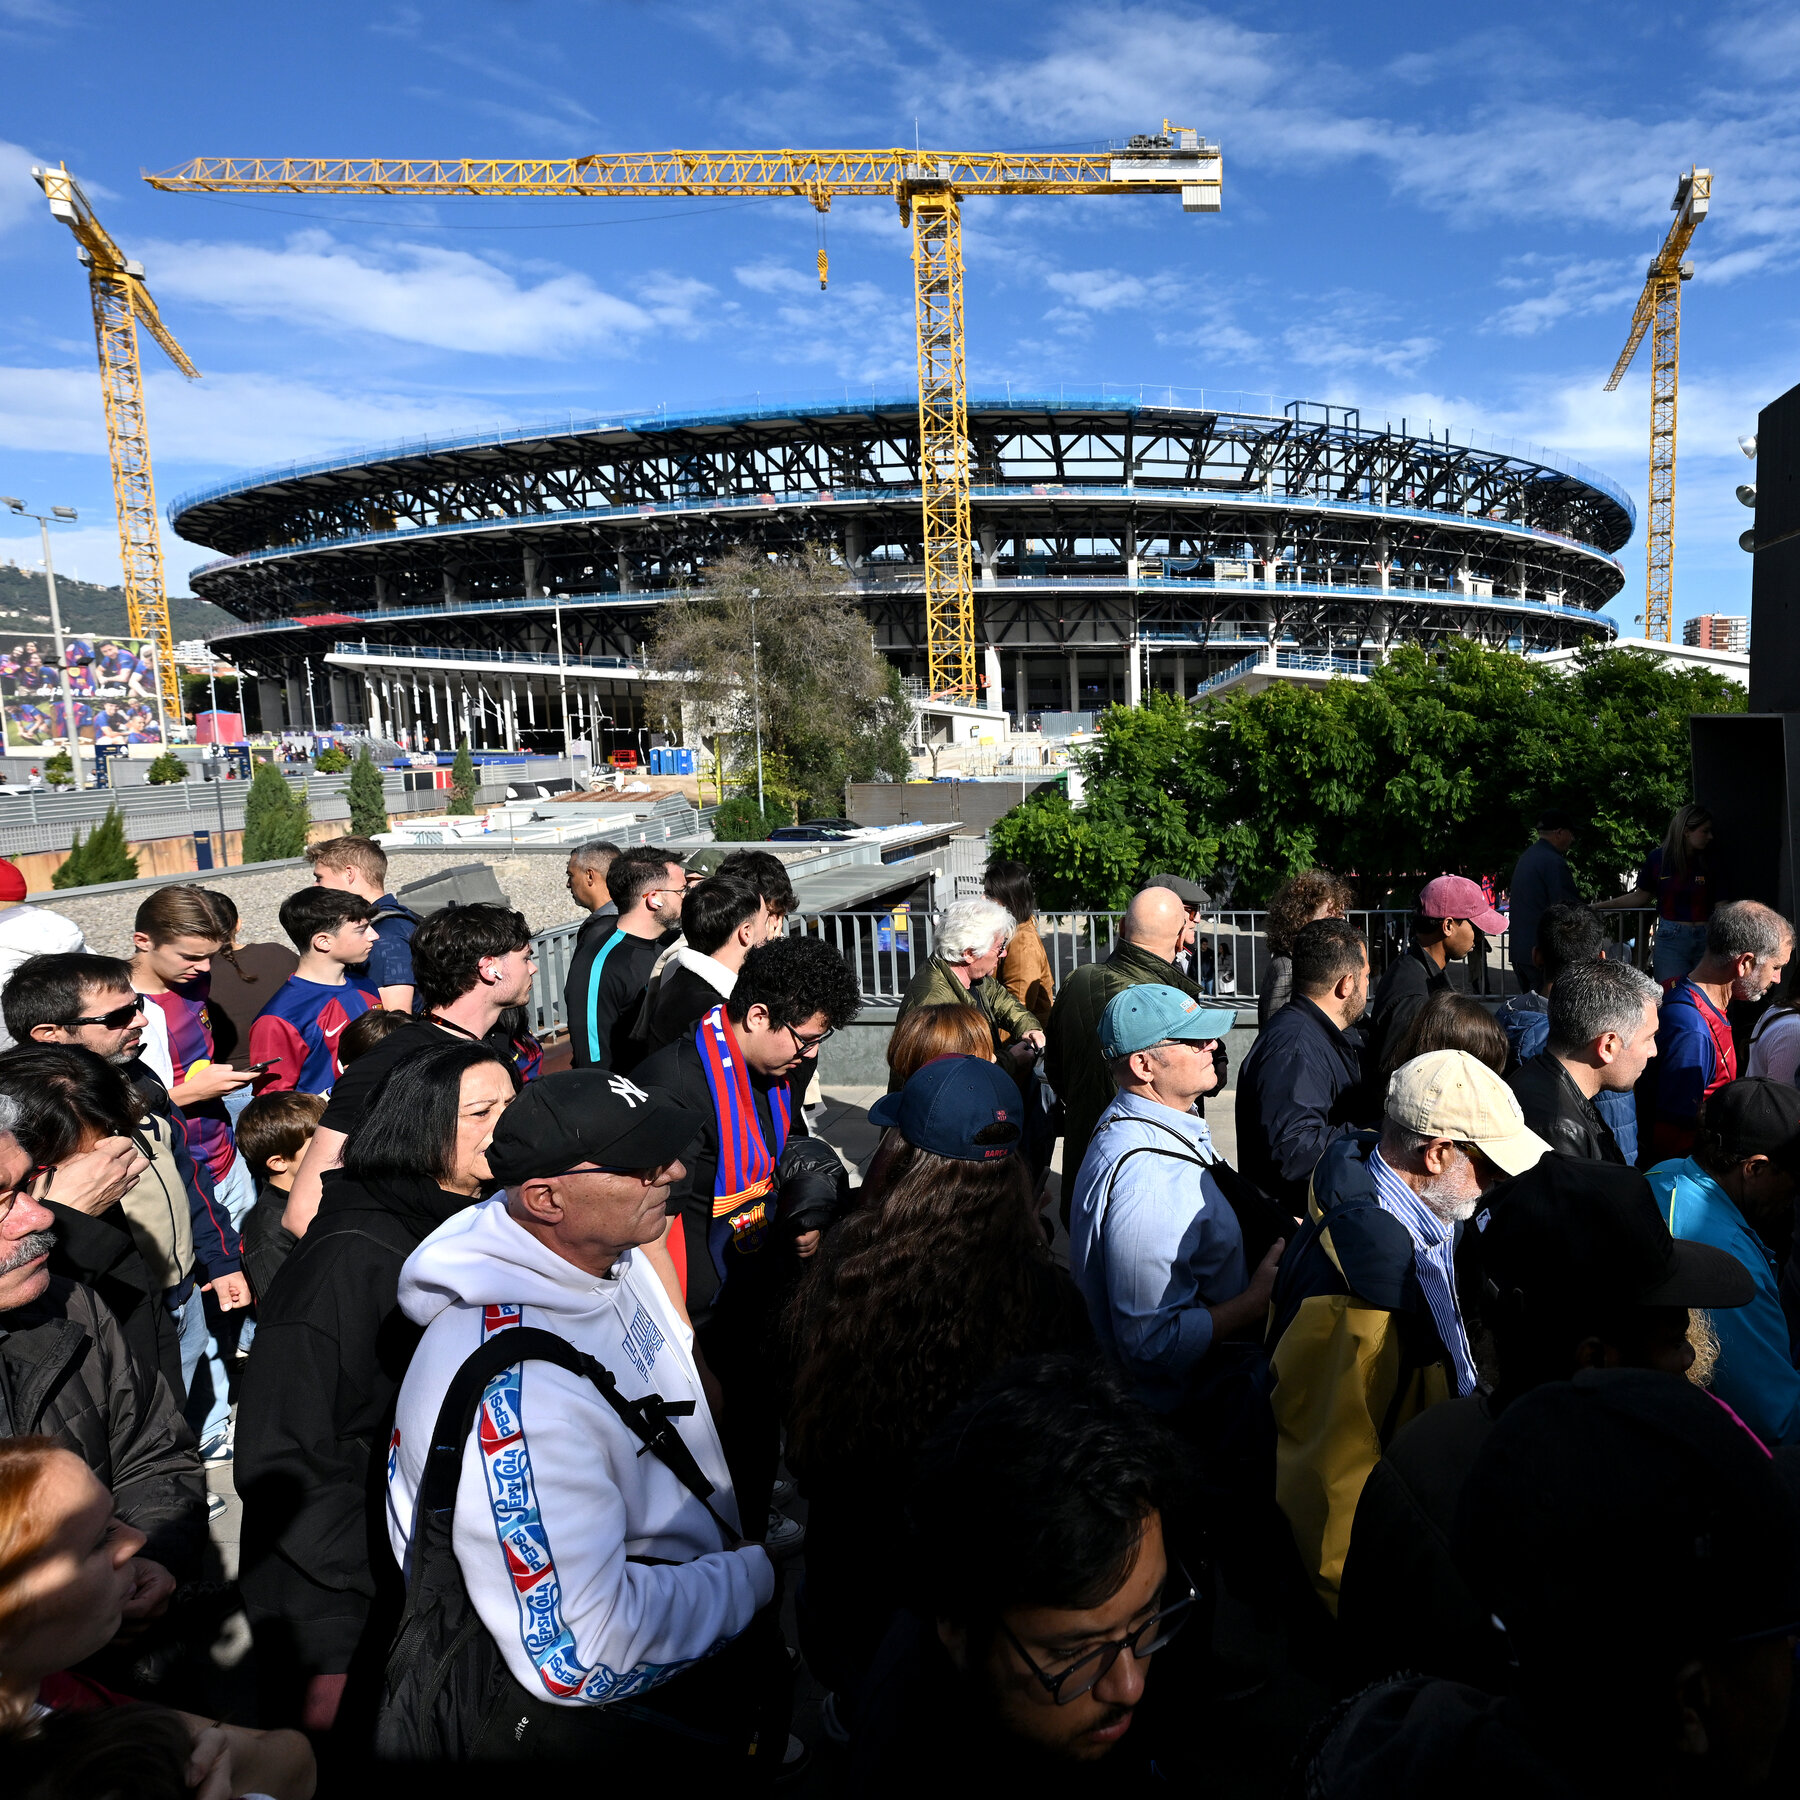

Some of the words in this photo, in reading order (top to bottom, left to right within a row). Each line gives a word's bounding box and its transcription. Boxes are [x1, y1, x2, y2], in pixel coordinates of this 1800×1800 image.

[490, 1391, 515, 1438] PEPSI
[509, 1529, 545, 1572] PEPSI
[546, 1652, 583, 1686] PEPSI
